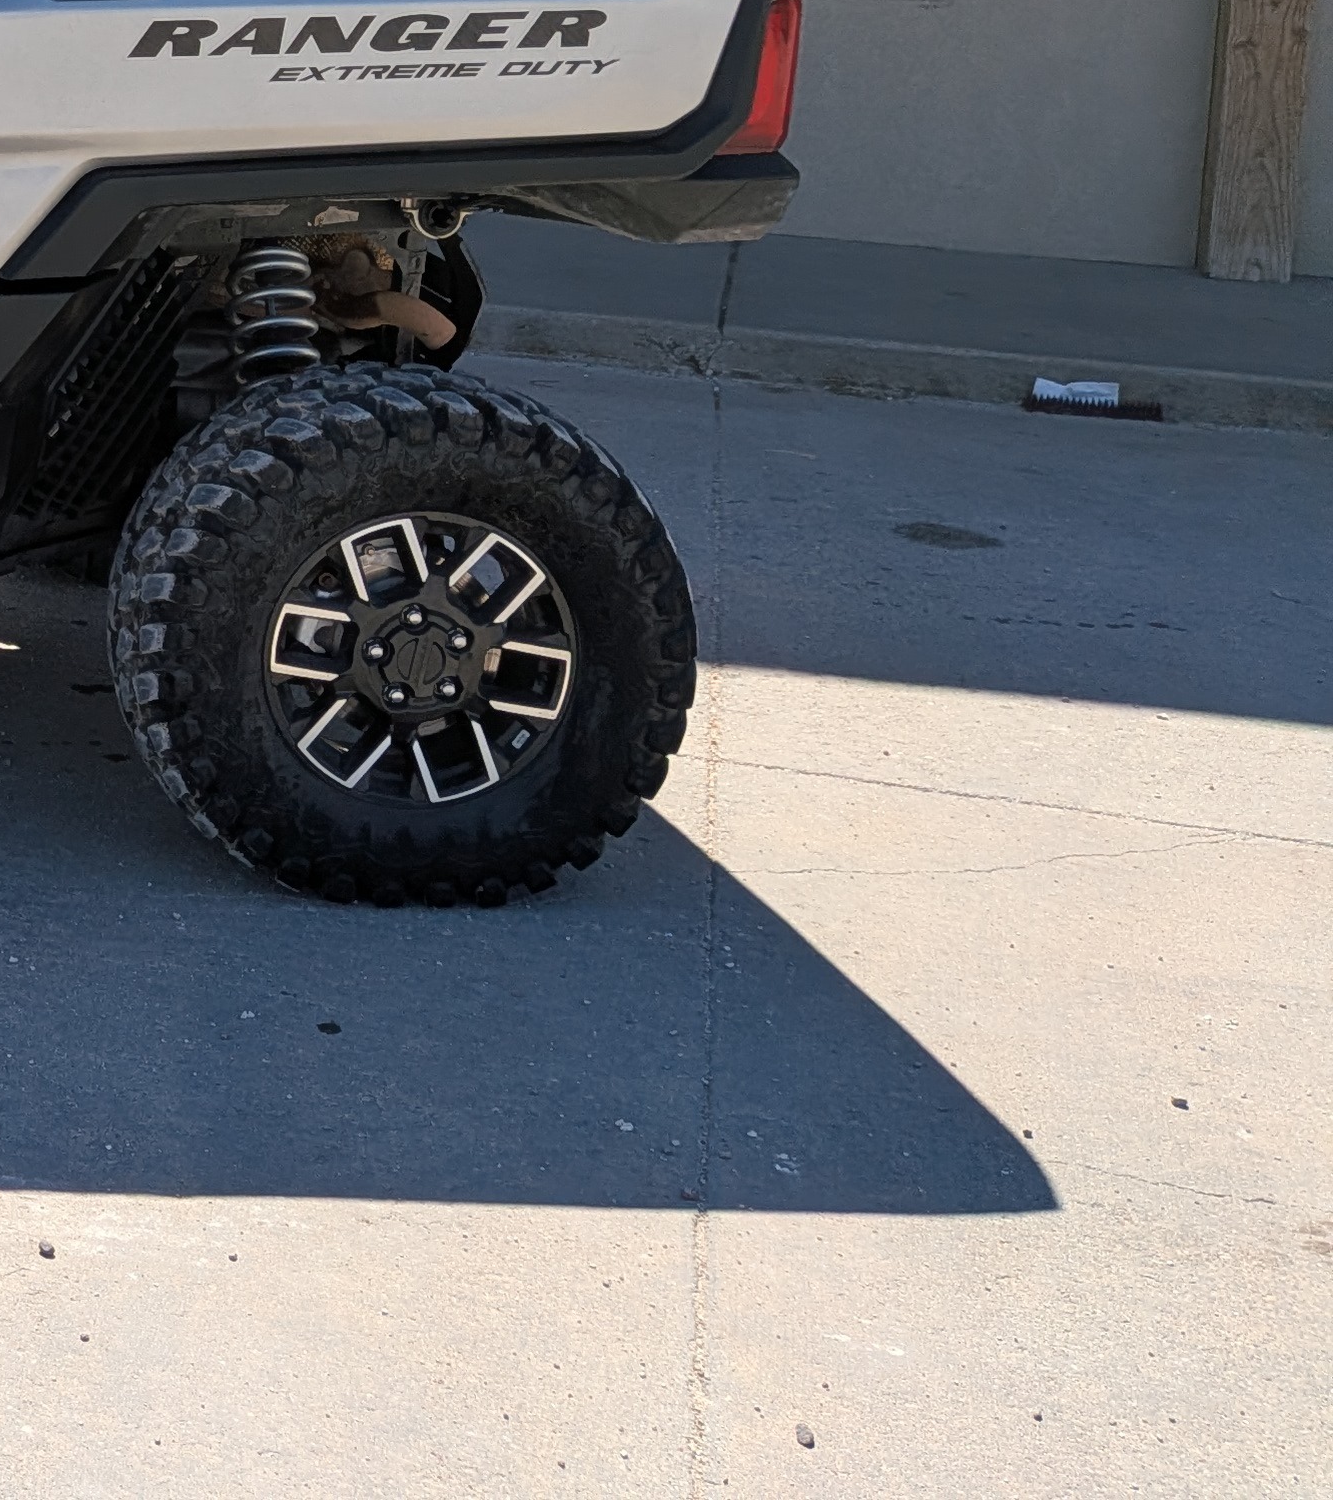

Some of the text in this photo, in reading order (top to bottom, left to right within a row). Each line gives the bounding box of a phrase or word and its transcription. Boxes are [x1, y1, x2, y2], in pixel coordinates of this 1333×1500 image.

[128, 10, 607, 57] RANGER
[269, 59, 619, 82] EXTREME DUTY
